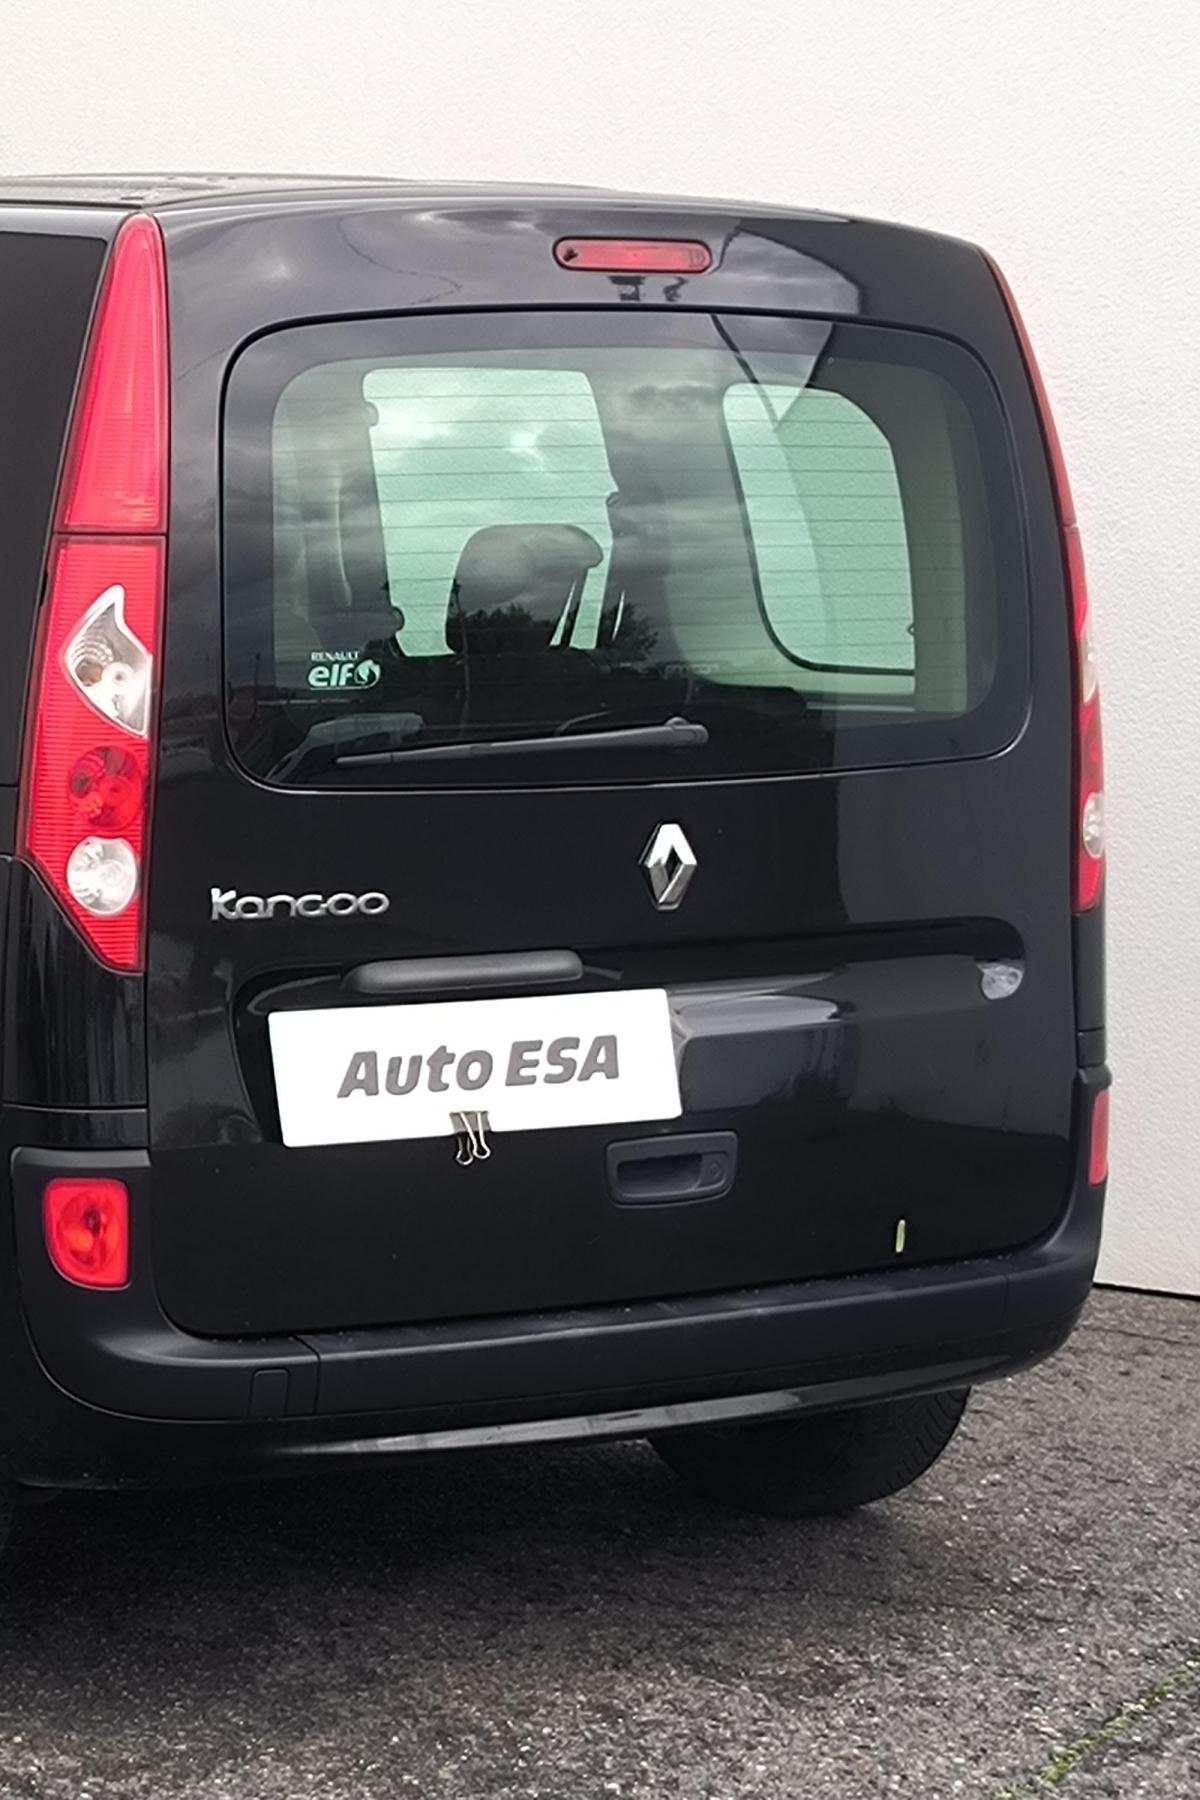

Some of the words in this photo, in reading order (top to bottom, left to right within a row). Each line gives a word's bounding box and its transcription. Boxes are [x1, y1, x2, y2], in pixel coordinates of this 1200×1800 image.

[308, 663, 354, 686] elf
[211, 888, 390, 920] Kangoo
[337, 1045, 493, 1098] Auto
[505, 1034, 620, 1087] ESA
